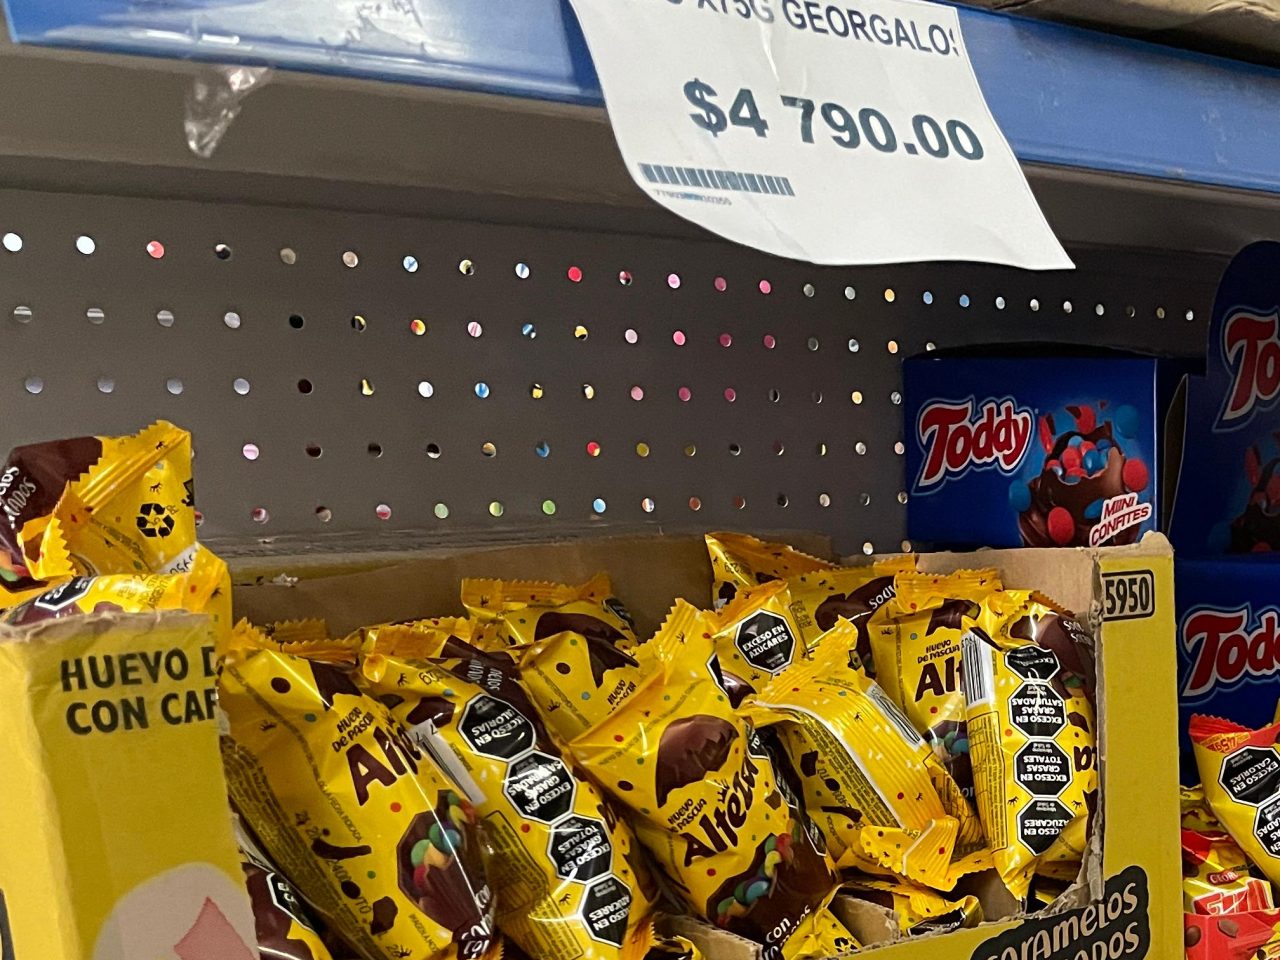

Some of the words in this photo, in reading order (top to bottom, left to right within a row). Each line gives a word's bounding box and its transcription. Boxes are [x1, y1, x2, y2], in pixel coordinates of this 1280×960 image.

[683, 77, 769, 138] $4
[779, 95, 985, 161] 790.00
[919, 400, 1032, 488] Toddy
[1104, 578, 1151, 616] 5950
[743, 630, 772, 652] EXCESO
[772, 624, 785, 636] EN
[61, 648, 190, 691] HUEVO
[66, 691, 149, 735] CON
[1015, 715, 1029, 724] EN
[1030, 715, 1063, 724] EXCESO
[1023, 755, 1063, 764] TOTALES
[1026, 764, 1061, 773] GRASAS
[1247, 759, 1280, 785] EXCESO
[1020, 773, 1034, 782] EN
[1034, 773, 1068, 782] EXCESO
[1232, 782, 1247, 793] EN
[1024, 828, 1038, 836] EN
